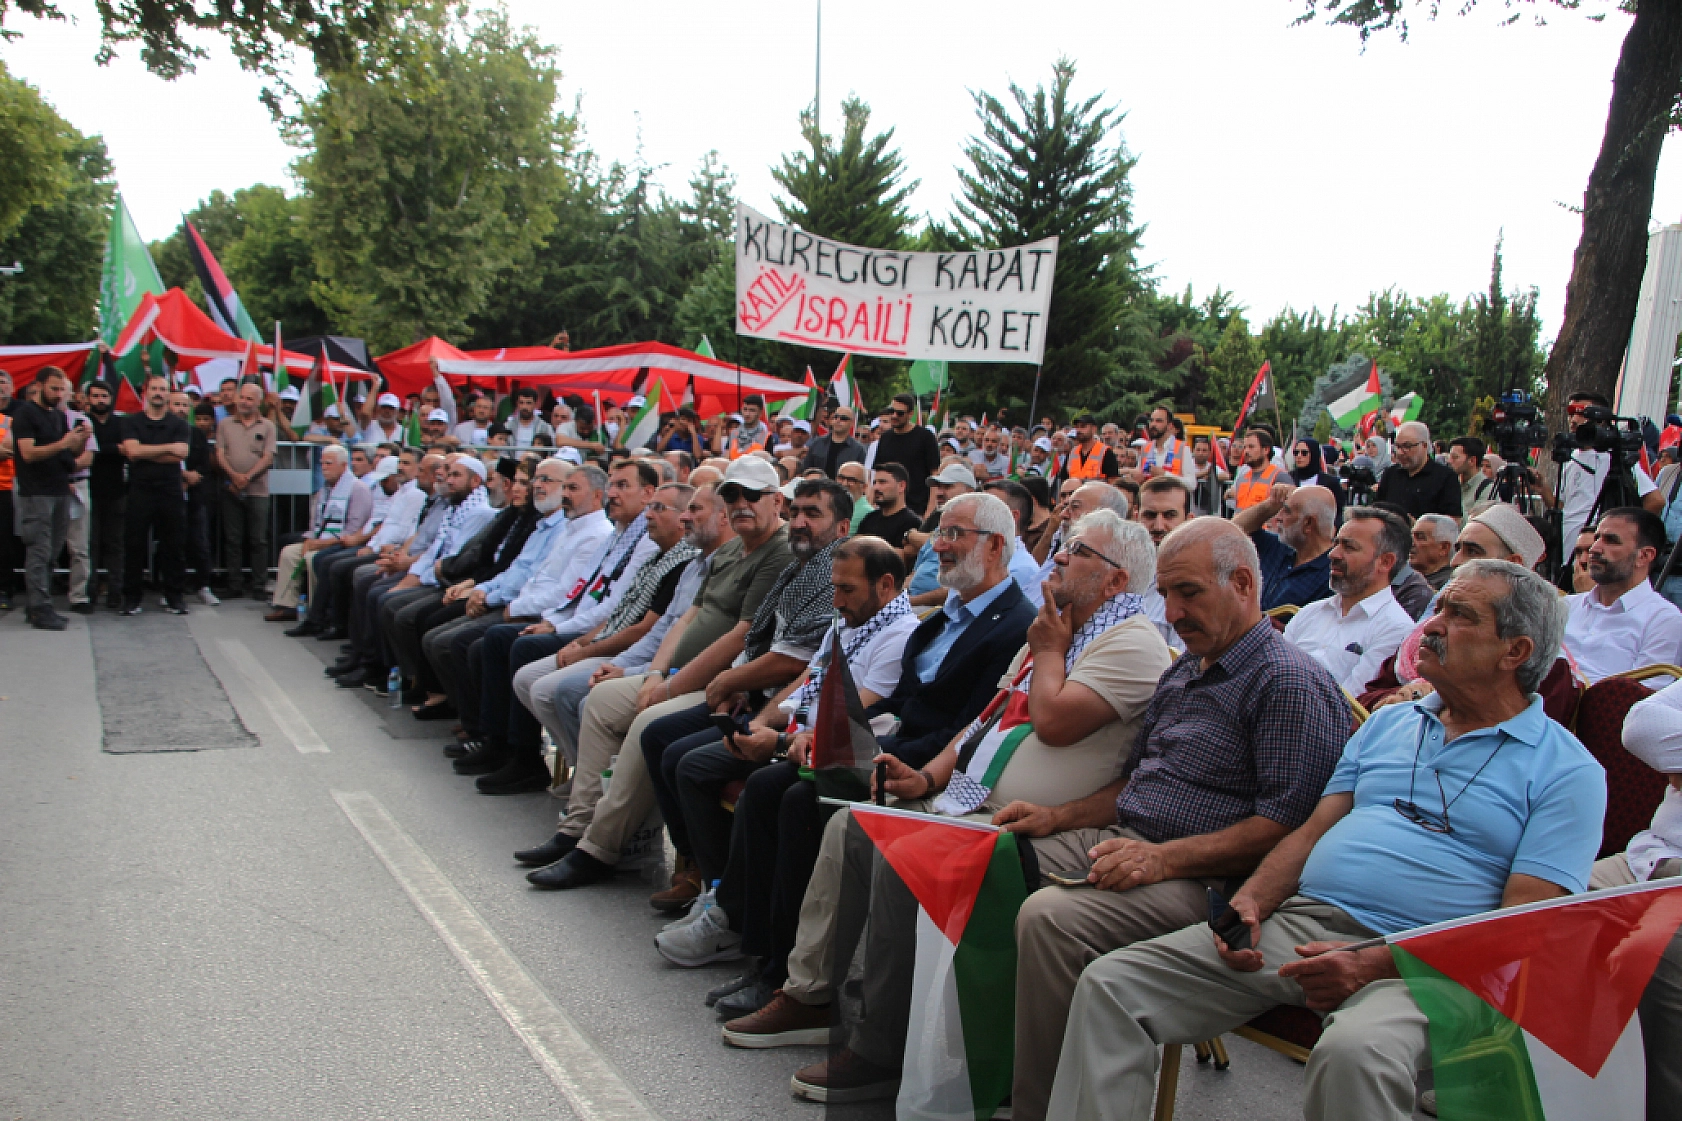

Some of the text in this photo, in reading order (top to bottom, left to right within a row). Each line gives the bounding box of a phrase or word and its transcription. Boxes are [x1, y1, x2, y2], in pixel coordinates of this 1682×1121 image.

[935, 249, 1052, 292] KAPAT
[739, 265, 798, 331] KATİL
[930, 301, 990, 350] KÖR
[1000, 310, 1041, 352] ET
